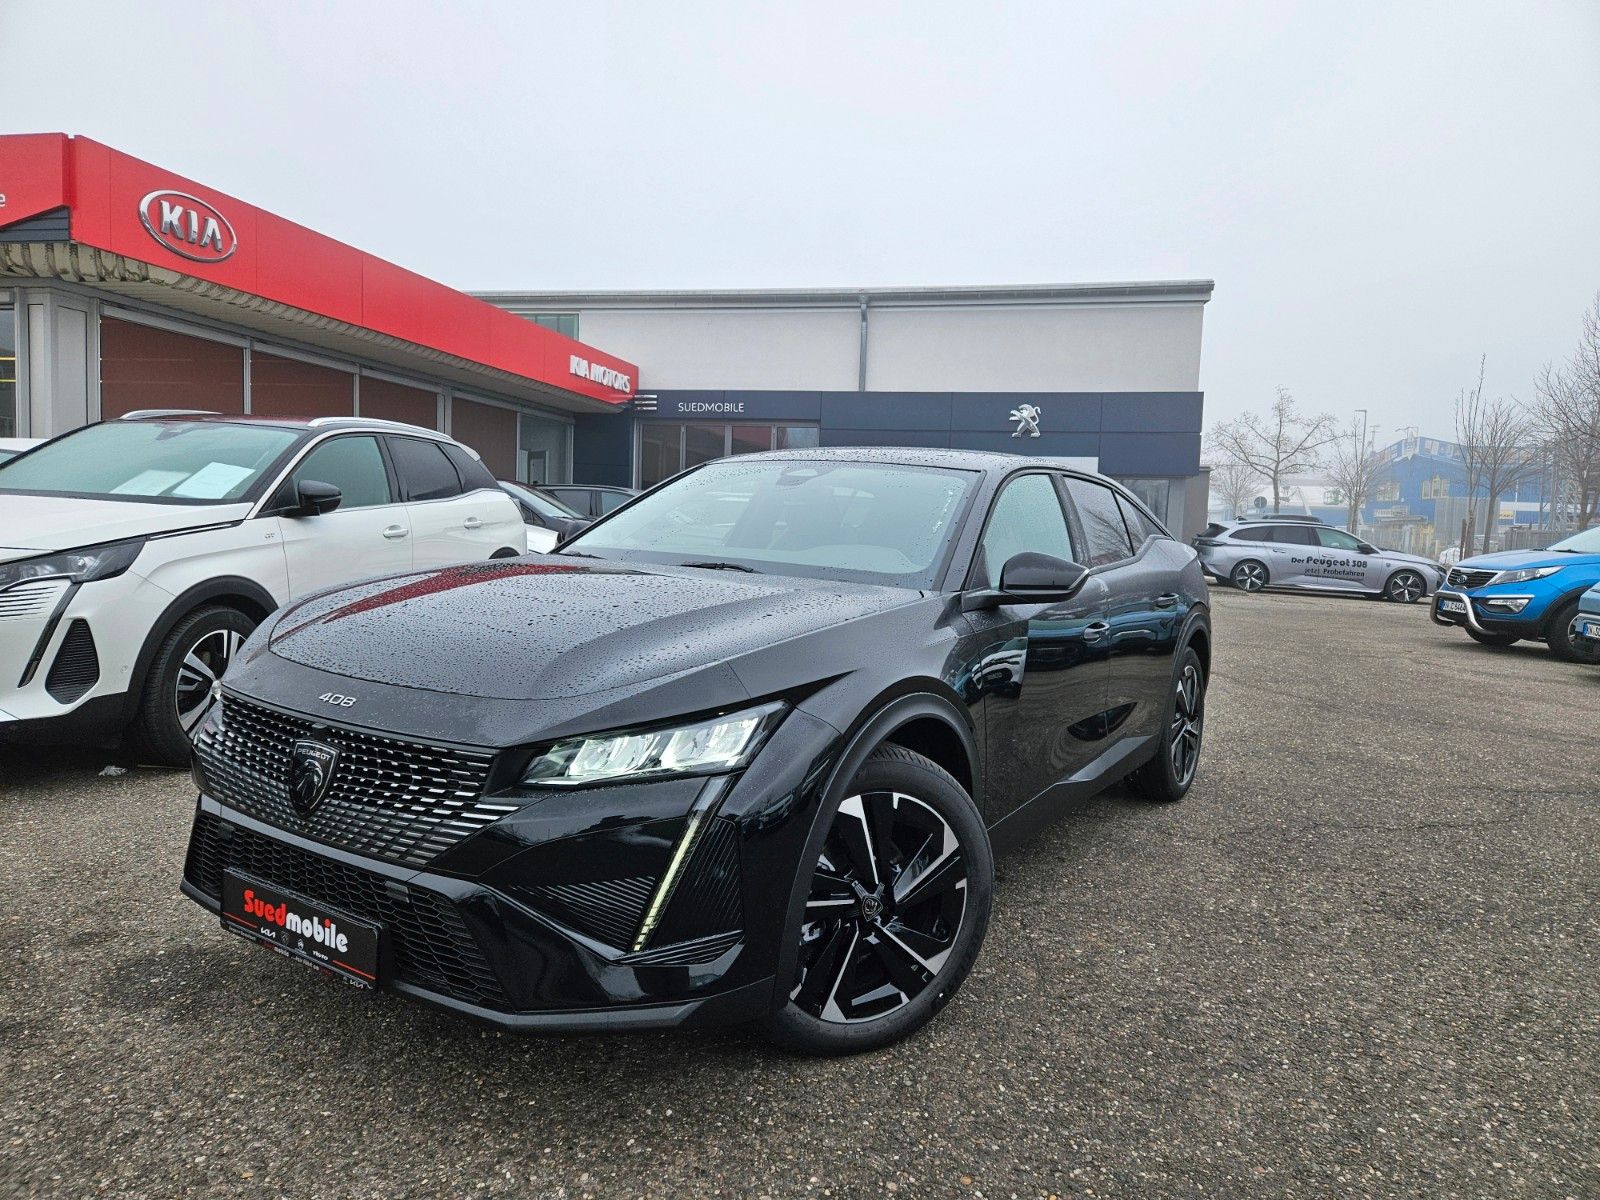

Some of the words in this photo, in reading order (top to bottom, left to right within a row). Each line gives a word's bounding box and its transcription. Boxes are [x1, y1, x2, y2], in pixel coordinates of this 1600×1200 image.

[160, 199, 223, 252] KIA
[570, 355, 589, 378] KIA
[591, 363, 630, 393] MOTORS
[678, 402, 745, 413] SUEDMOBILE
[1306, 556, 1350, 567] Peugeot
[1351, 560, 1368, 568] 308
[1323, 568, 1365, 577] Probefahren
[319, 692, 357, 707] 408
[297, 748, 331, 760] PEUGEOT
[244, 889, 348, 953] Suedmobile
